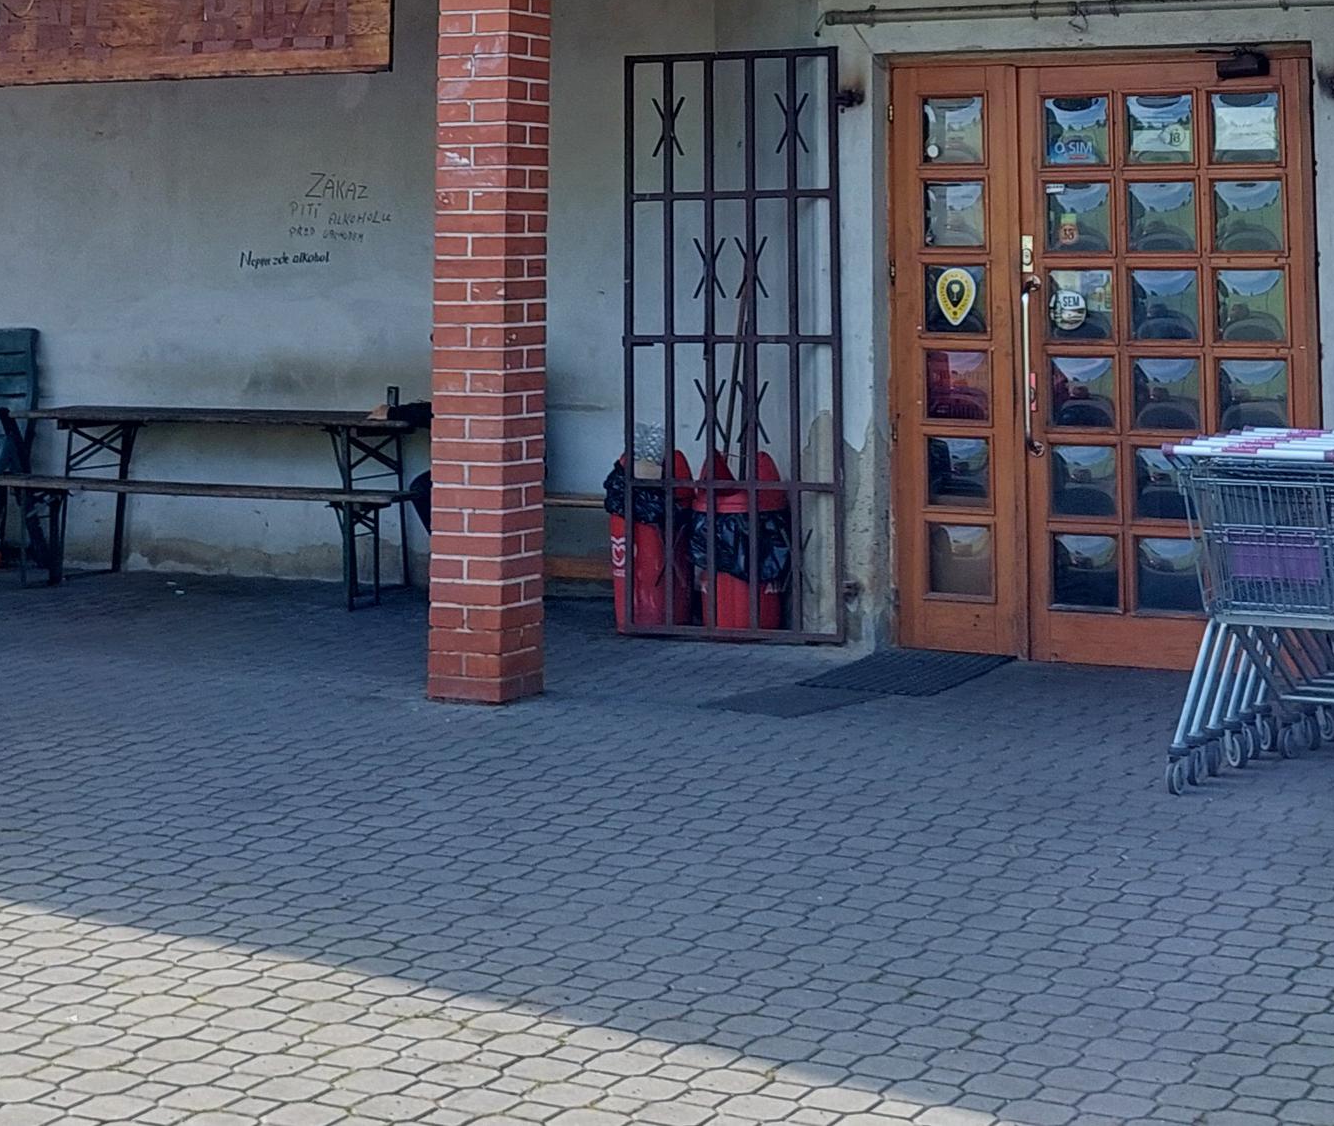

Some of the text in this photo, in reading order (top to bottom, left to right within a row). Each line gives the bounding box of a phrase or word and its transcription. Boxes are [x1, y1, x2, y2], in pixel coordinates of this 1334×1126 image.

[1068, 140, 1092, 154] SIM
[305, 172, 369, 200] ZÁKAZ
[1062, 295, 1080, 308] SEM
